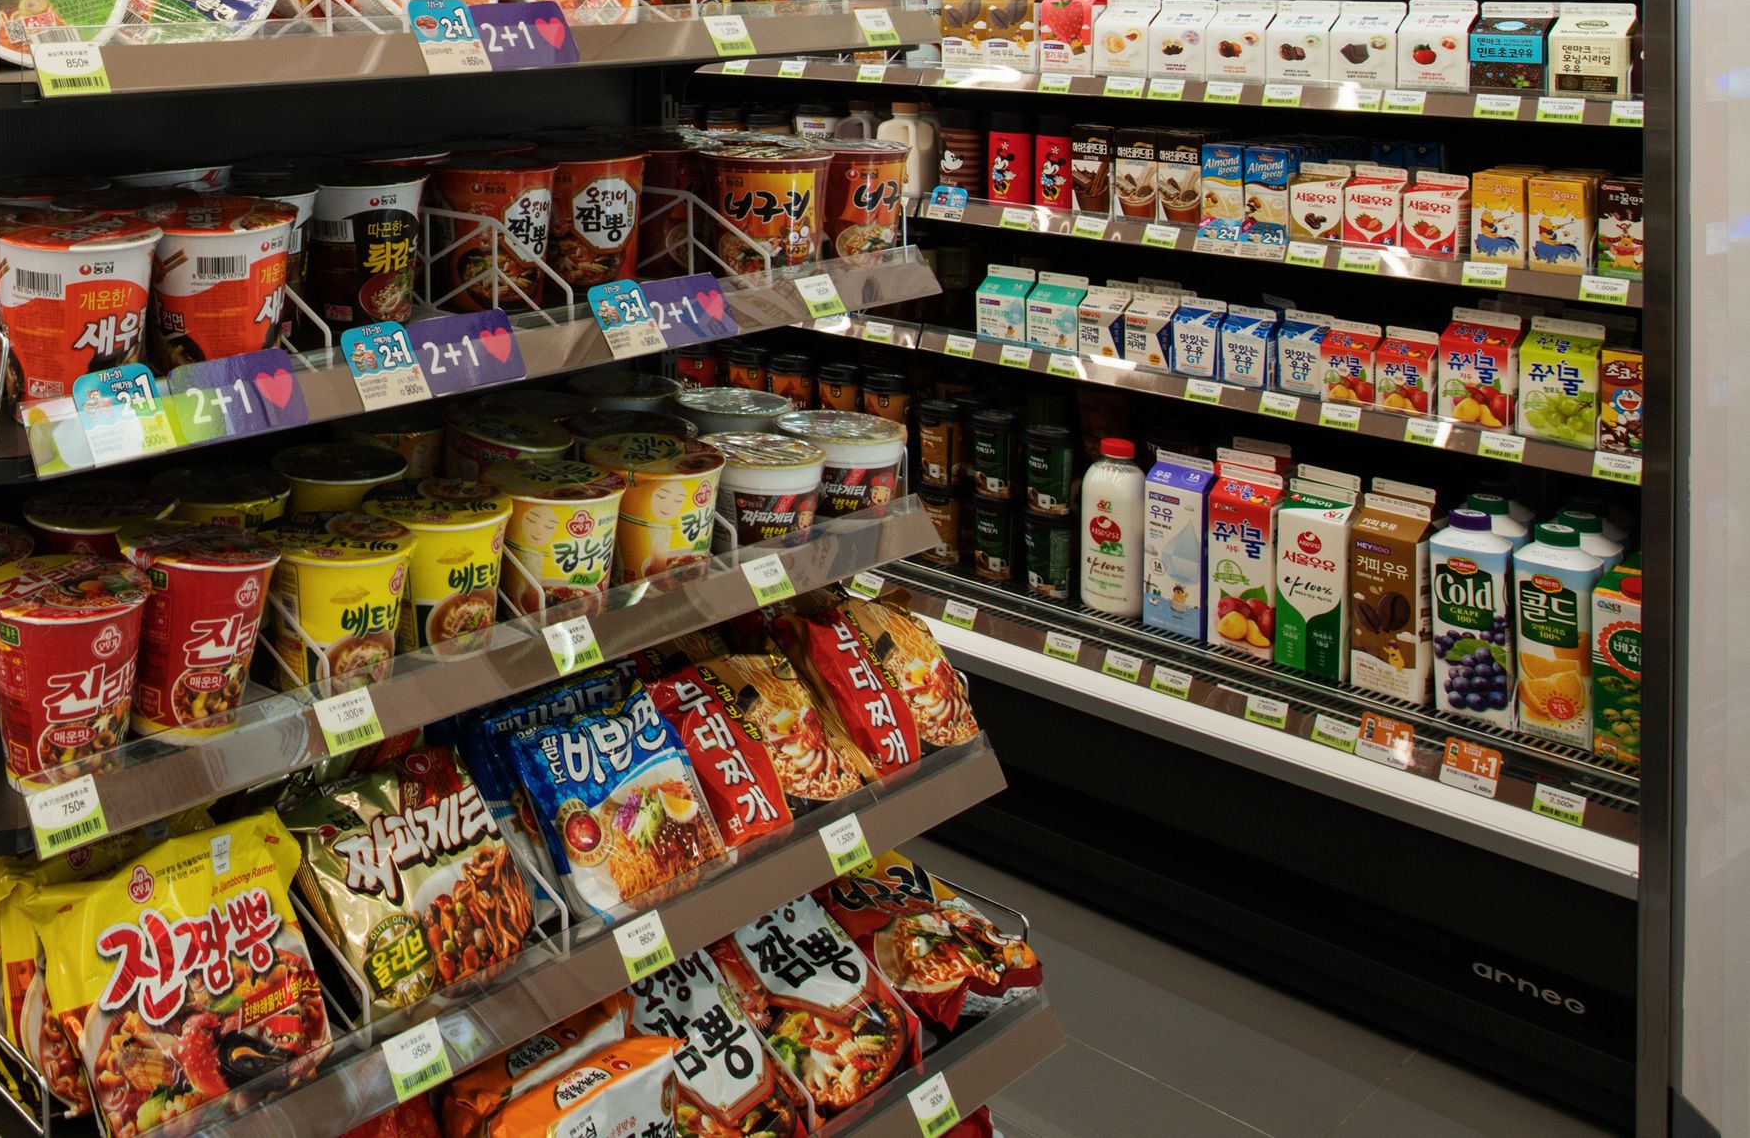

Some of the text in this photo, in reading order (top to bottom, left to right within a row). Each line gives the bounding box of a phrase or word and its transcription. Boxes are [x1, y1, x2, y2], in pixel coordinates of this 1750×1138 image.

[440, 7, 473, 41] 2+1
[481, 21, 535, 53] 2+1
[66, 58, 90, 69] 850원
[1562, 53, 1611, 65] 모닝시리얼
[1562, 65, 1582, 74] 우유
[1205, 156, 1240, 169] Almond
[1218, 164, 1240, 174] Breeze
[1247, 160, 1284, 174] Almond
[1261, 167, 1284, 180] Breeze
[586, 182, 630, 209] 오징어
[1296, 191, 1337, 204] 서울우유
[1350, 193, 1393, 207] 서울우유
[724, 189, 812, 224] 너구리
[1408, 199, 1451, 214] 서울우유
[574, 203, 630, 248] 짬뽕
[1218, 224, 1240, 241] 2+1
[1263, 228, 1285, 246] 2+1
[93, 264, 115, 275] 농심
[79, 286, 132, 312] 개운한!
[620, 289, 649, 322] 2+1
[651, 296, 699, 330] 2+1
[1180, 332, 1209, 346] 맛있는
[379, 331, 412, 368] 2+1
[422, 335, 480, 374] 2+1
[1184, 345, 1204, 357] 우유
[1228, 343, 1259, 358] 맛있는
[1186, 354, 1201, 365] GT
[1232, 355, 1252, 366] 우유
[1329, 354, 1363, 377] 쥬시쿨
[1448, 349, 1499, 385] 쥬시쿨
[1235, 364, 1251, 375] GT
[1384, 361, 1420, 386] 쥬시쿨
[1529, 359, 1584, 396] 쥬시쿨
[117, 374, 158, 413] 2+1
[185, 377, 254, 426] 2+1
[830, 493, 860, 511] 범벅
[741, 509, 798, 528] 짜파게티
[1150, 504, 1174, 522] 우유
[1361, 517, 1398, 531] 커피 우유
[1212, 519, 1265, 560] 쥬시쿨
[1282, 550, 1337, 573] 서울우유
[1356, 555, 1409, 580] 커피 우유
[1435, 572, 1493, 611] Cold
[1450, 607, 1479, 619] GRAPE
[1521, 588, 1577, 626] 콜드
[1457, 615, 1478, 624] 100%
[1539, 630, 1561, 642] 100%
[189, 673, 222, 688] 매운맛
[834, 621, 910, 767] 부대찌개
[53, 728, 91, 745] 매운맛
[562, 691, 667, 784] 비빔면
[674, 679, 778, 823] 부대찌개
[1471, 756, 1497, 779] 1+1
[62, 800, 86, 816] 750원
[334, 786, 500, 901] 짜파게티
[98, 888, 282, 1026] 진짬뽕
[368, 927, 429, 988] 올리브
